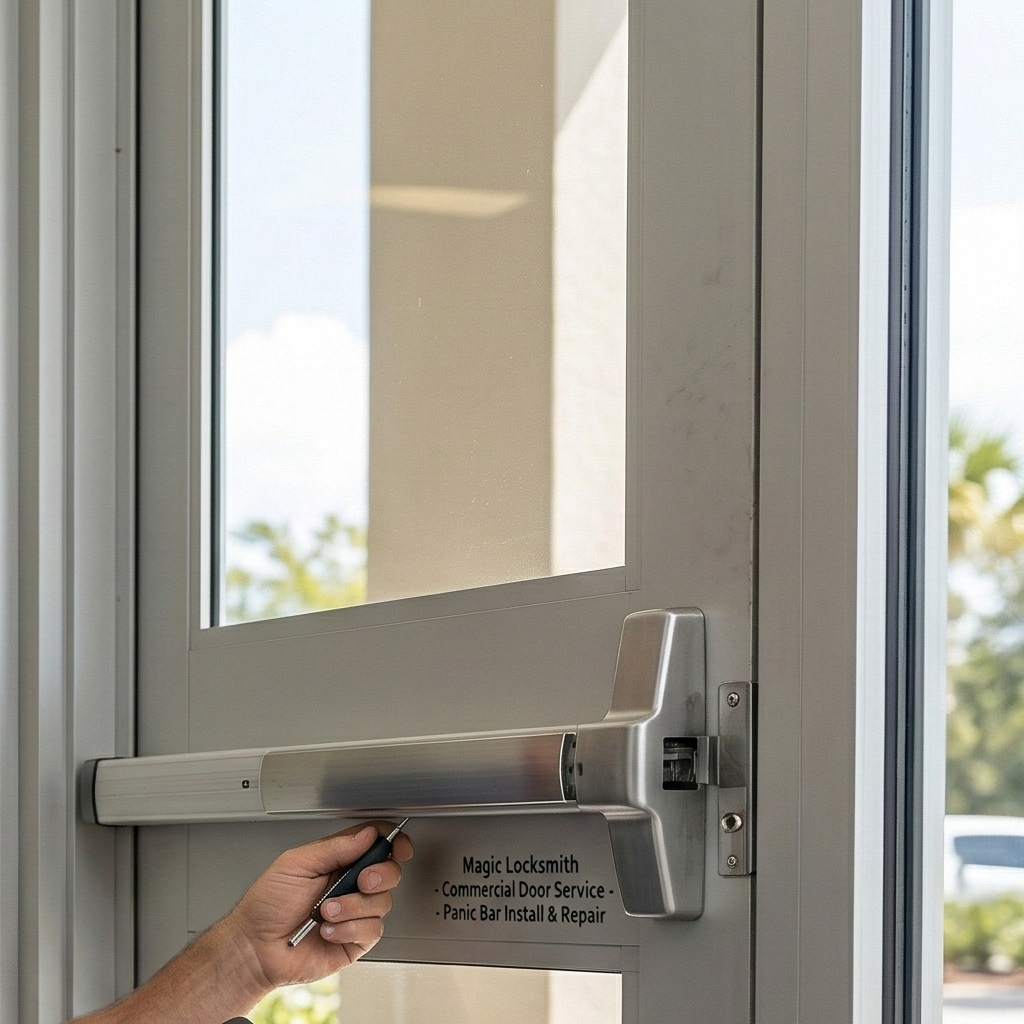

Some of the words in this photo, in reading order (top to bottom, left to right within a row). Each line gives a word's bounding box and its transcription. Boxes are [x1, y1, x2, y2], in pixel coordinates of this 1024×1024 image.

[463, 855, 502, 878] Magic
[506, 854, 579, 874] Locksmith
[442, 879, 515, 898] Commercial
[519, 881, 551, 899] Door
[554, 880, 605, 899] Service
[443, 903, 476, 921] Panic
[480, 904, 501, 922] Bar
[504, 905, 544, 922] Install
[547, 905, 558, 923] &
[561, 905, 606, 927] Repair
